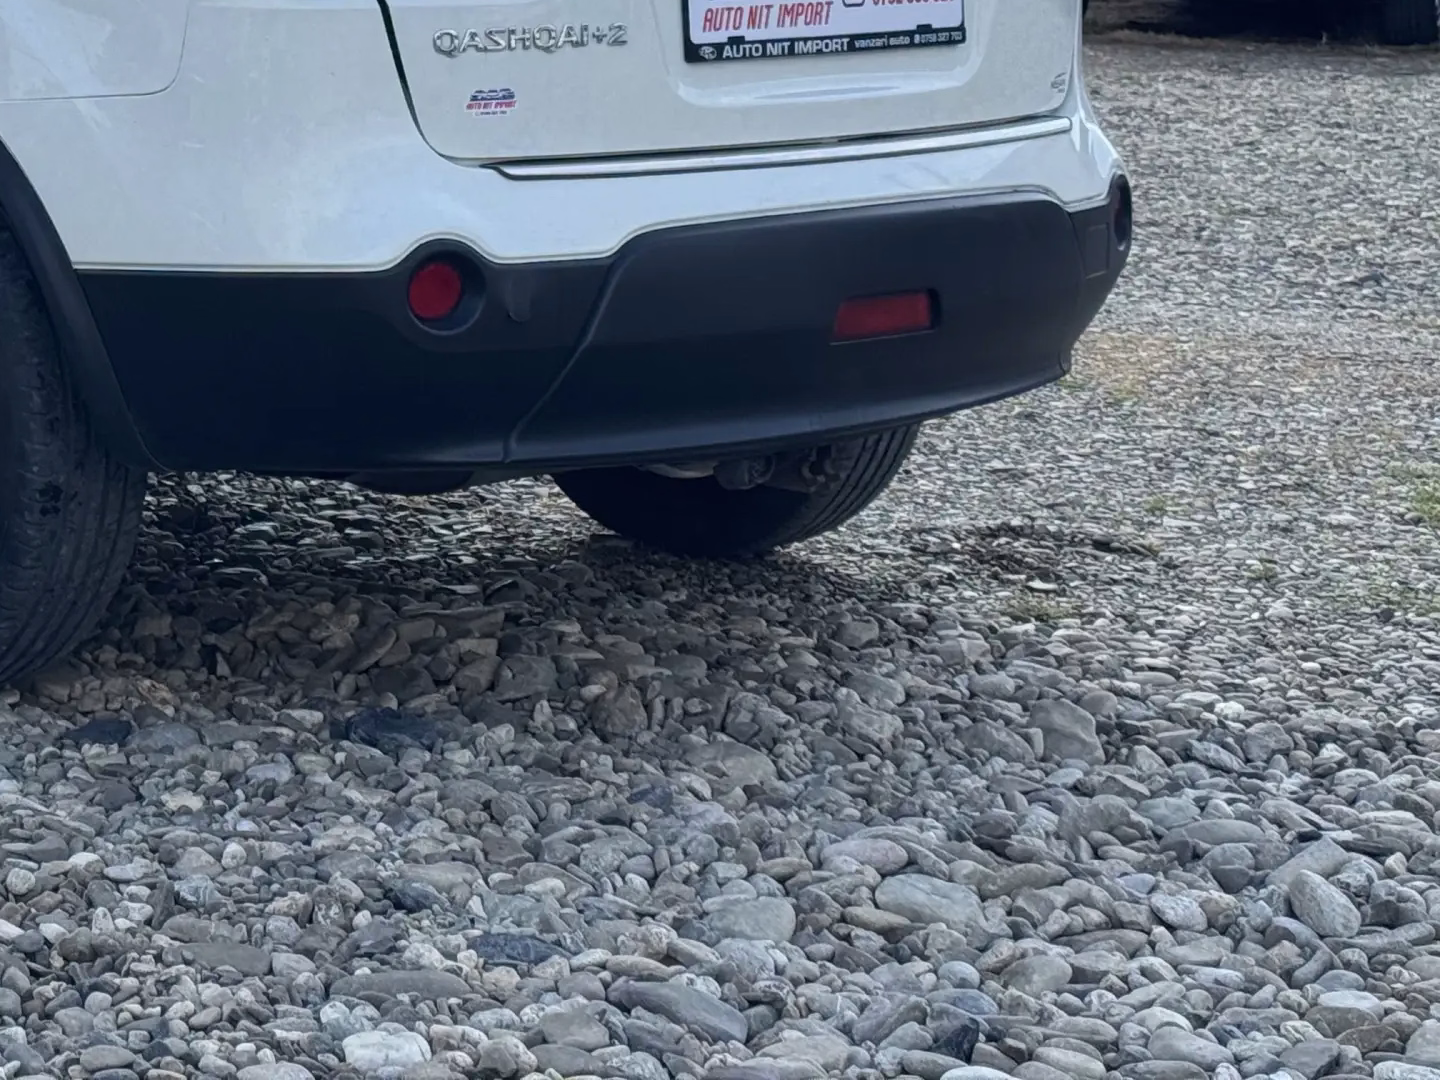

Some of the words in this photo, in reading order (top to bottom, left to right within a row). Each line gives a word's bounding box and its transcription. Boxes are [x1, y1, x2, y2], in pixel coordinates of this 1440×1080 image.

[702, 6, 745, 33] AUTO
[747, 4, 774, 30] NIT
[776, 1, 834, 28] IMPORT
[722, 43, 763, 60] AUTO
[766, 41, 791, 57] NIT
[794, 37, 851, 54] IMPORT
